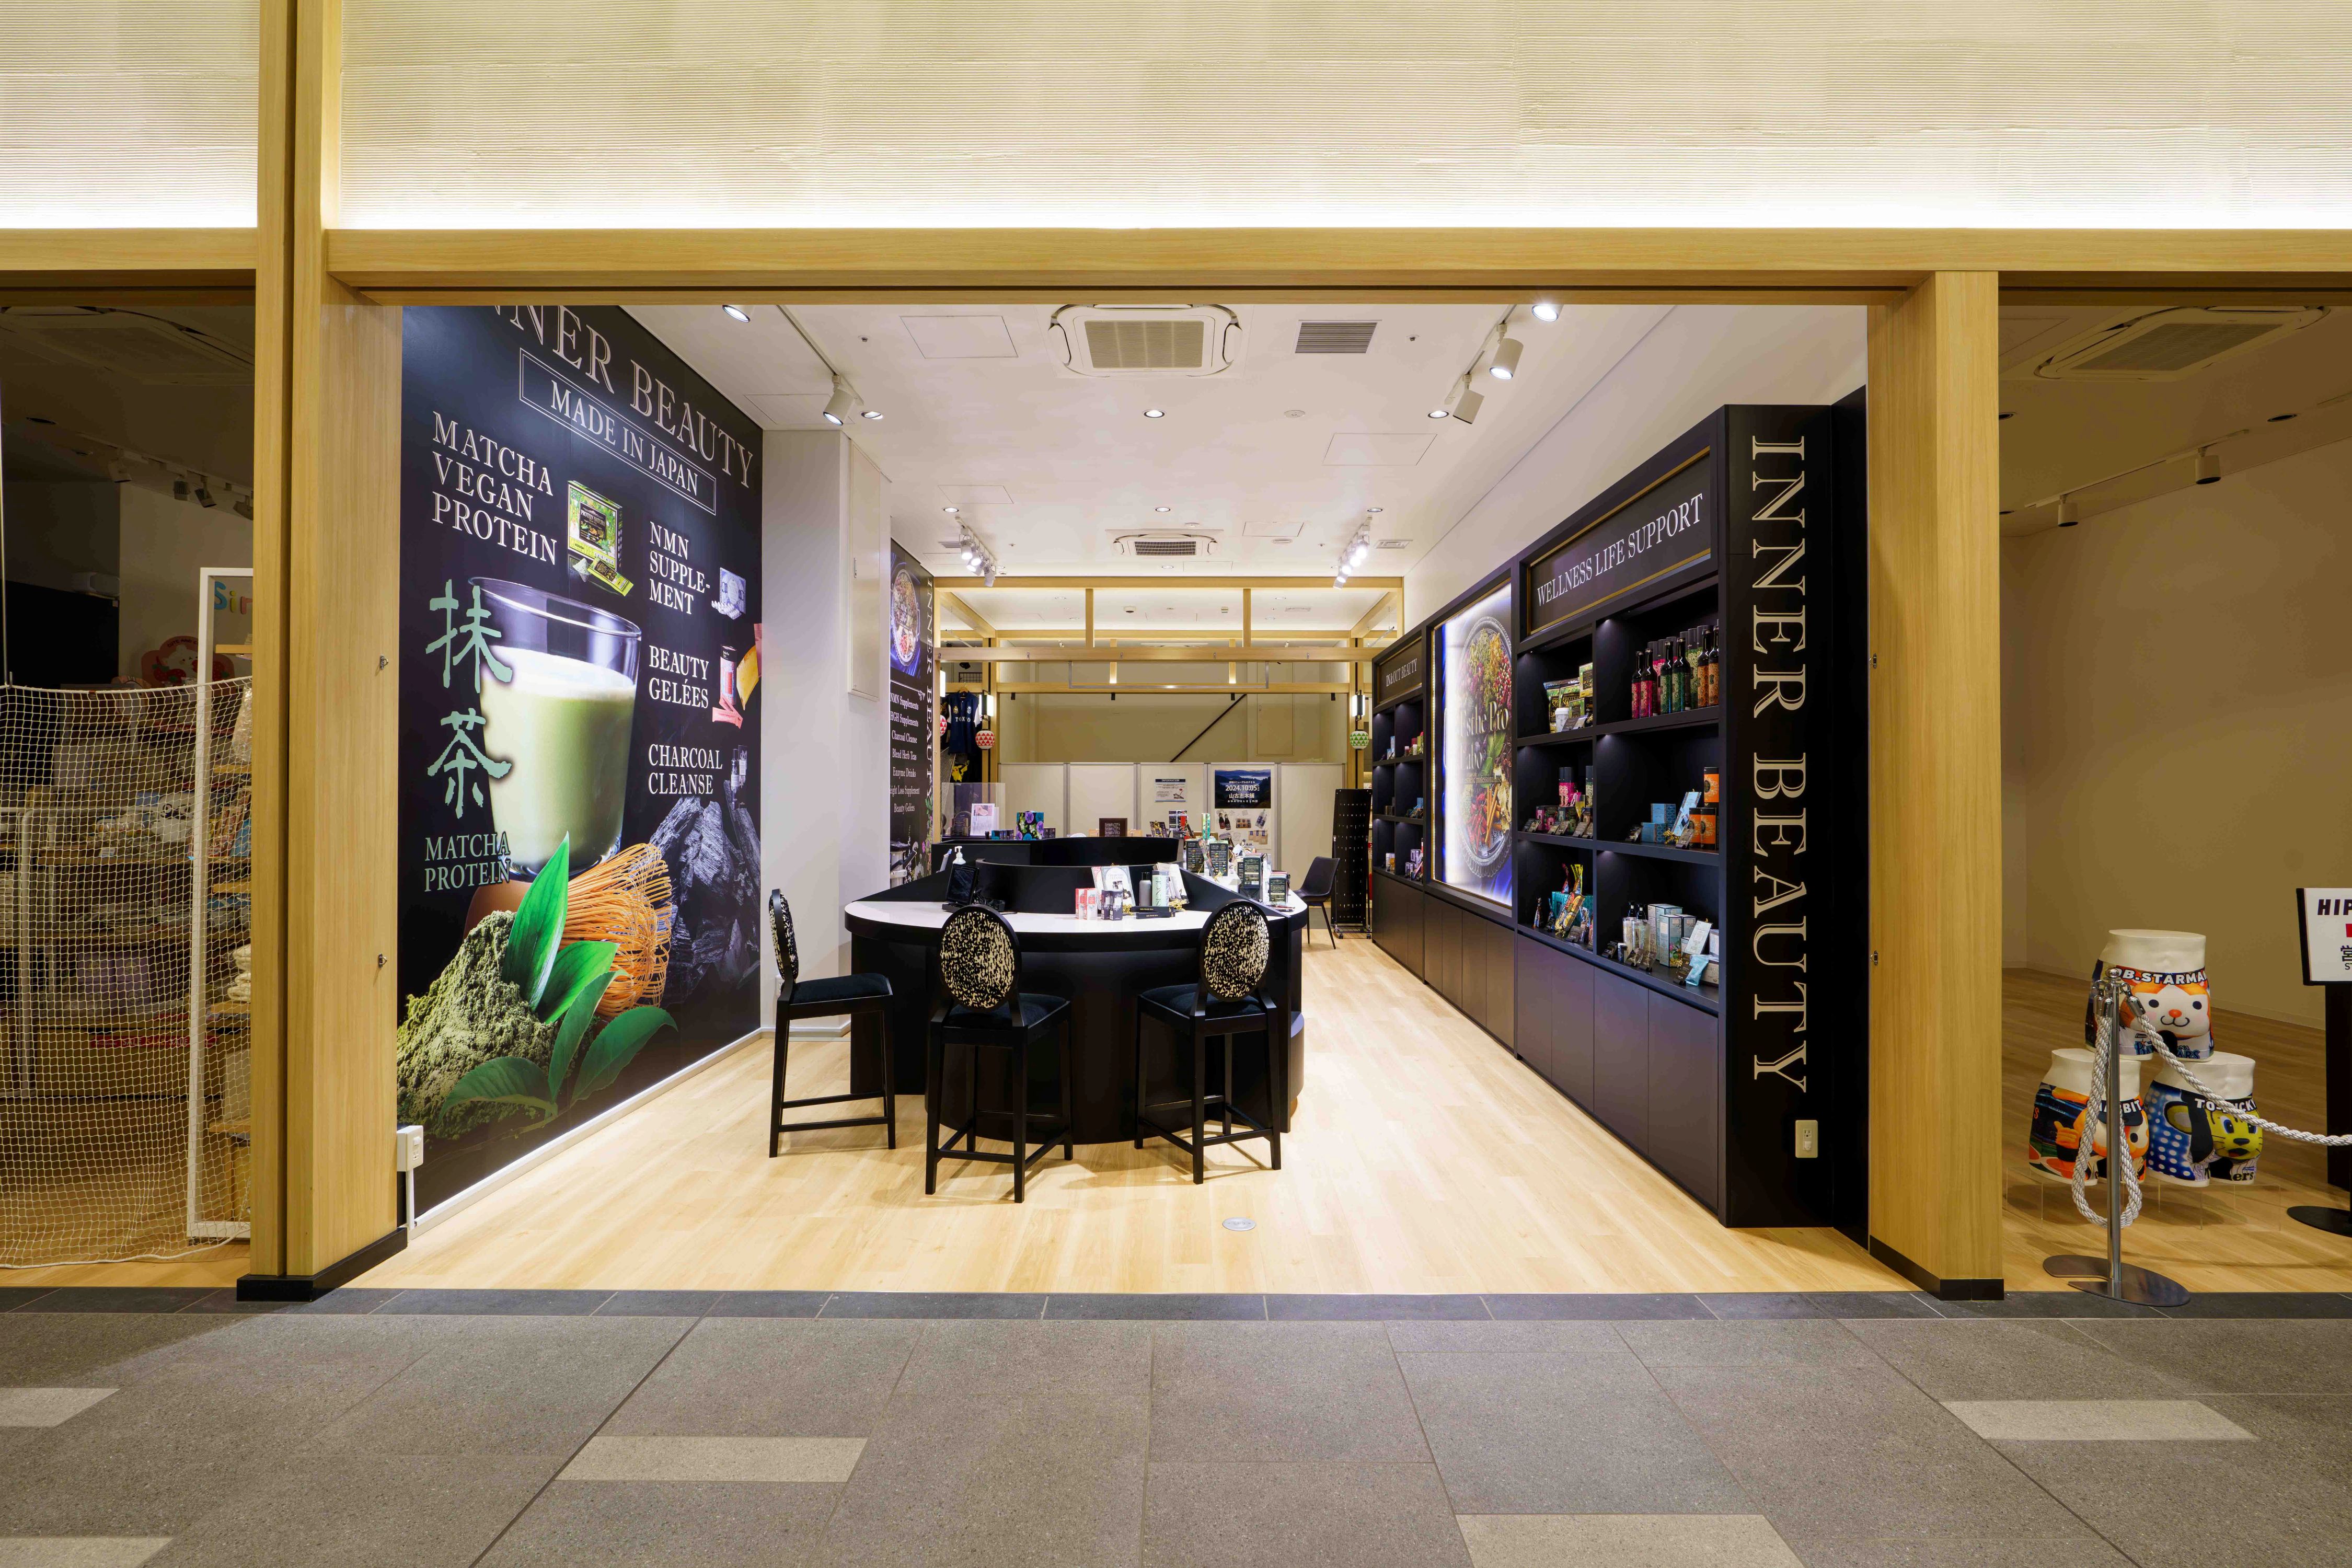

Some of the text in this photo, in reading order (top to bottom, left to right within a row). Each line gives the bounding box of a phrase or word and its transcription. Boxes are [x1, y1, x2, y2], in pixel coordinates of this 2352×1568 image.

[494, 305, 753, 489] NER BEAUTY
[550, 379, 698, 496] MADE IN JAPAN
[433, 411, 554, 497] MATCHA
[432, 451, 534, 522] VEGAN
[432, 491, 557, 566] PROTEIN
[650, 521, 689, 560] NMN
[1537, 493, 1703, 607] WELLNESS LIFE SUPPORT
[650, 550, 710, 593] SUPPLE-
[649, 578, 694, 615] MENT
[649, 645, 710, 681] BEAUTY
[1401, 658, 1417, 678] BEAUTY
[425, 579, 513, 820] 抹茶
[649, 677, 709, 709] GELÉES
[890, 693, 919, 710] NMN Supplements
[890, 711, 919, 727] HGH Supplements
[1489, 701, 1509, 732] Pro
[892, 730, 917, 744] Charcoal Cleanse
[892, 748, 902, 758] Blend
[648, 744, 723, 769] CHARCOAL
[1751, 435, 1807, 1093] INNER BEAUTY
[648, 773, 714, 795] CLEANSE
[893, 767, 916, 779] Enzyme Drinks
[905, 785, 920, 797] Supplement
[894, 803, 905, 814] Beauty
[425, 831, 510, 861] MATCHA
[424, 860, 510, 892] PROTEIN
